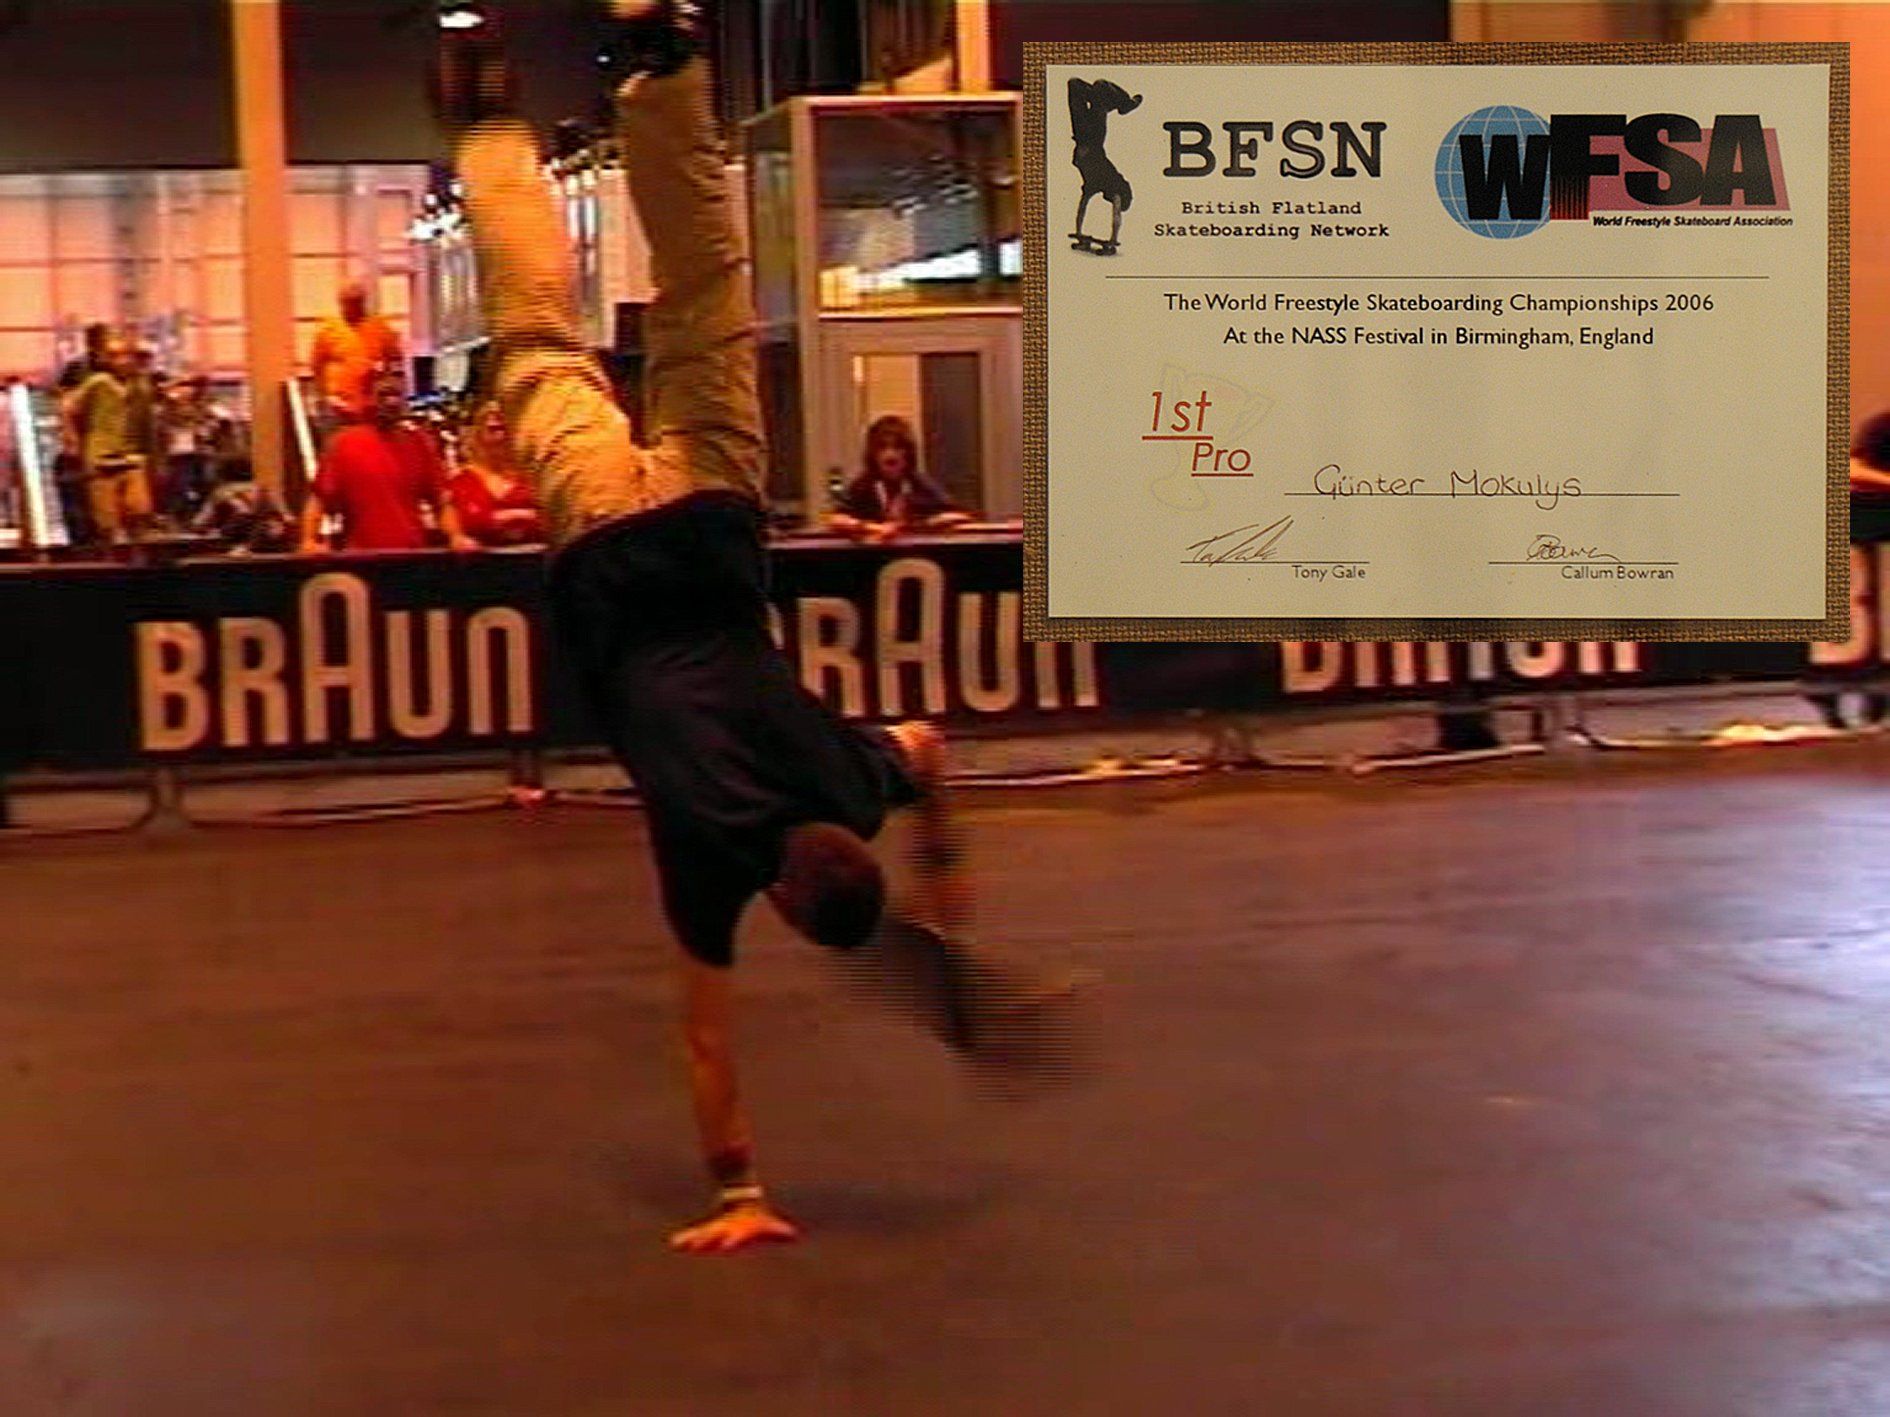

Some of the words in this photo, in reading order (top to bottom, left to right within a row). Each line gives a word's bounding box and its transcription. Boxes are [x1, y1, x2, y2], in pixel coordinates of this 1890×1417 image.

[1162, 119, 1388, 180] BFSN
[1459, 113, 1777, 220] WFSA
[1181, 201, 1261, 215] British
[1272, 200, 1362, 215] Flatland
[1154, 223, 1301, 241] Skateboarding
[1310, 223, 1390, 237] Network
[1592, 215, 1623, 227] World
[1624, 215, 1672, 229] Freestyle
[1673, 215, 1732, 227] Skateboard
[1732, 216, 1794, 227] Association
[1163, 293, 1202, 311] The
[1204, 293, 1267, 311] World
[1274, 293, 1360, 317] Freestyle
[1366, 293, 1504, 317] Skateboarding
[1509, 293, 1659, 317] Championships
[1665, 293, 1714, 311] 2006
[1223, 326, 1248, 345] At
[1254, 326, 1285, 345] the
[1291, 326, 1347, 345] NASS
[1354, 326, 1424, 345] Festival
[1431, 327, 1448, 345] in
[1455, 326, 1574, 350] Birmingham,
[1579, 326, 1654, 351] England
[1152, 390, 1213, 432] 1st
[1192, 442, 1251, 472] Pro
[1291, 564, 1328, 583] Tony
[1332, 564, 1366, 579] Gale
[1561, 565, 1614, 579] Callum
[1616, 565, 1674, 580] Bowran
[769, 557, 1099, 717] RAUN
[135, 572, 533, 751] BRAUN
